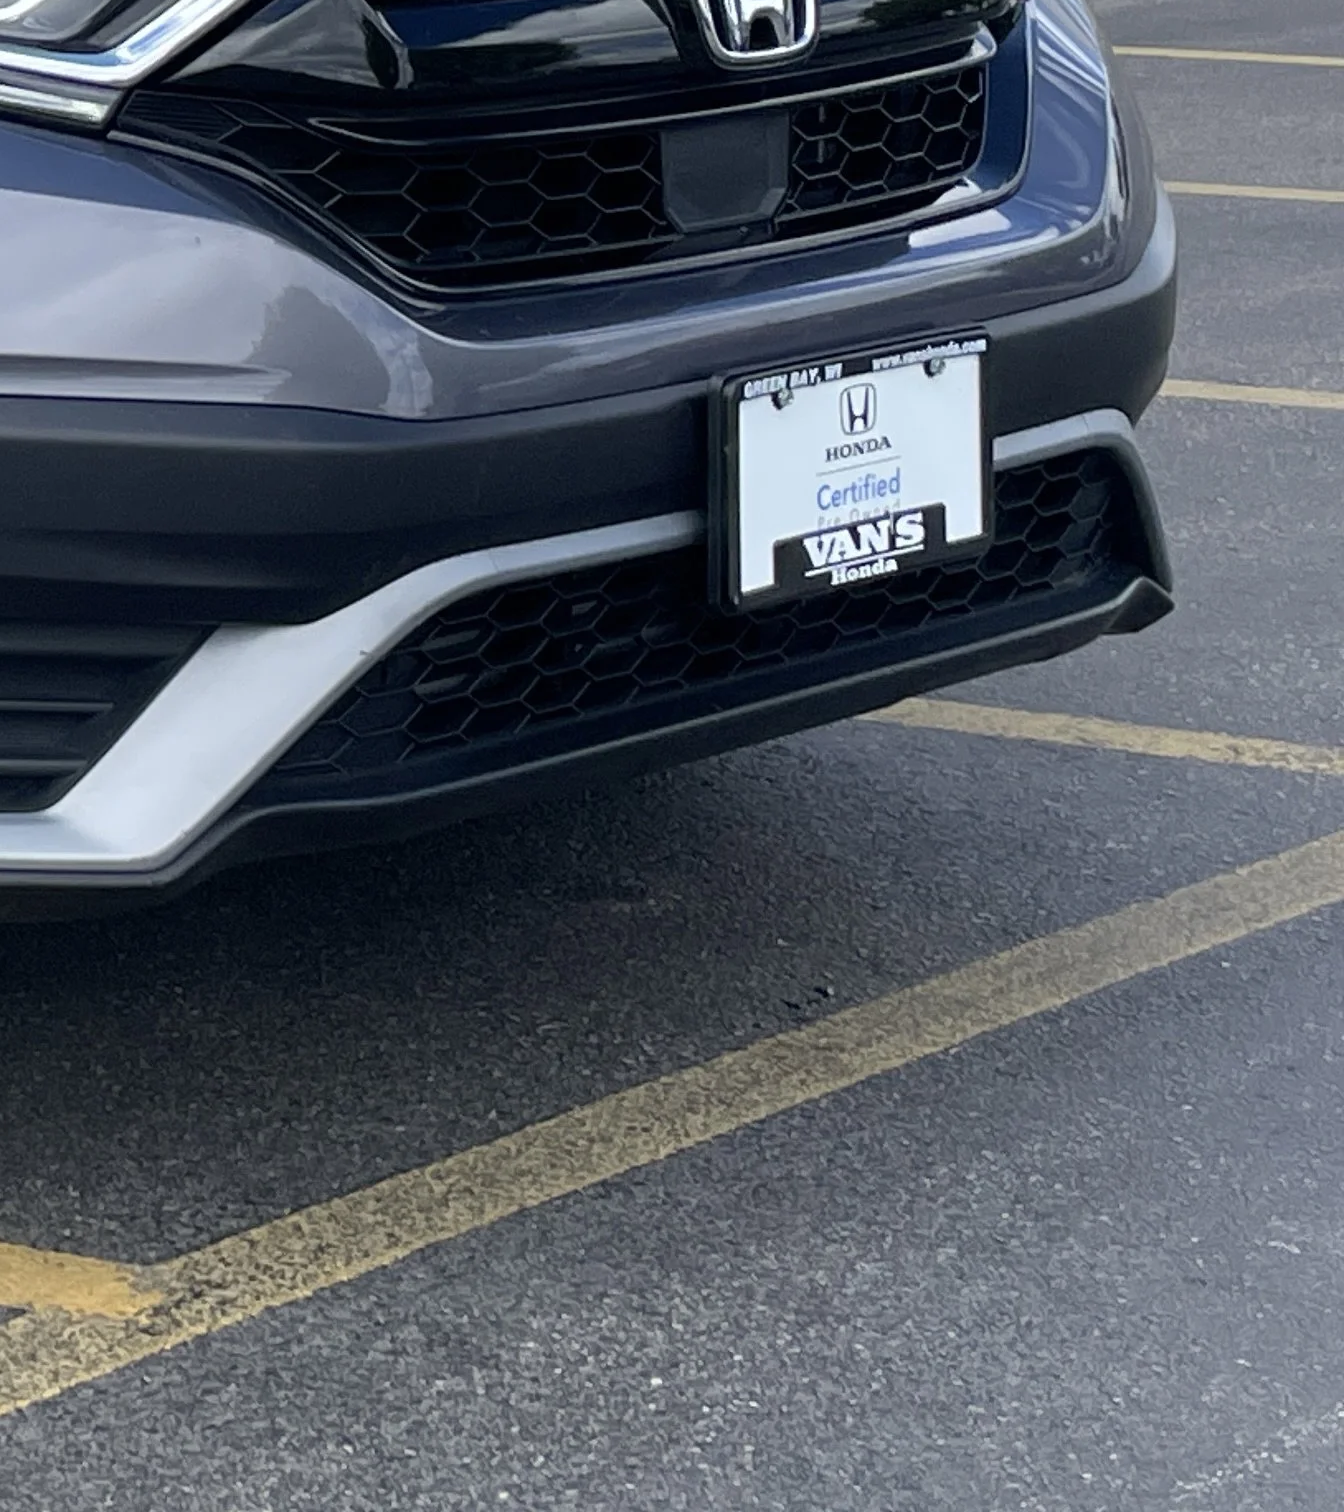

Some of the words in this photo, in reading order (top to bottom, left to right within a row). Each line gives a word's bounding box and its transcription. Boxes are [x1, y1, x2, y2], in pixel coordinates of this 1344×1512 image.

[825, 436, 892, 463] HONDA
[816, 465, 901, 511] Certified
[830, 558, 899, 586] Honda
